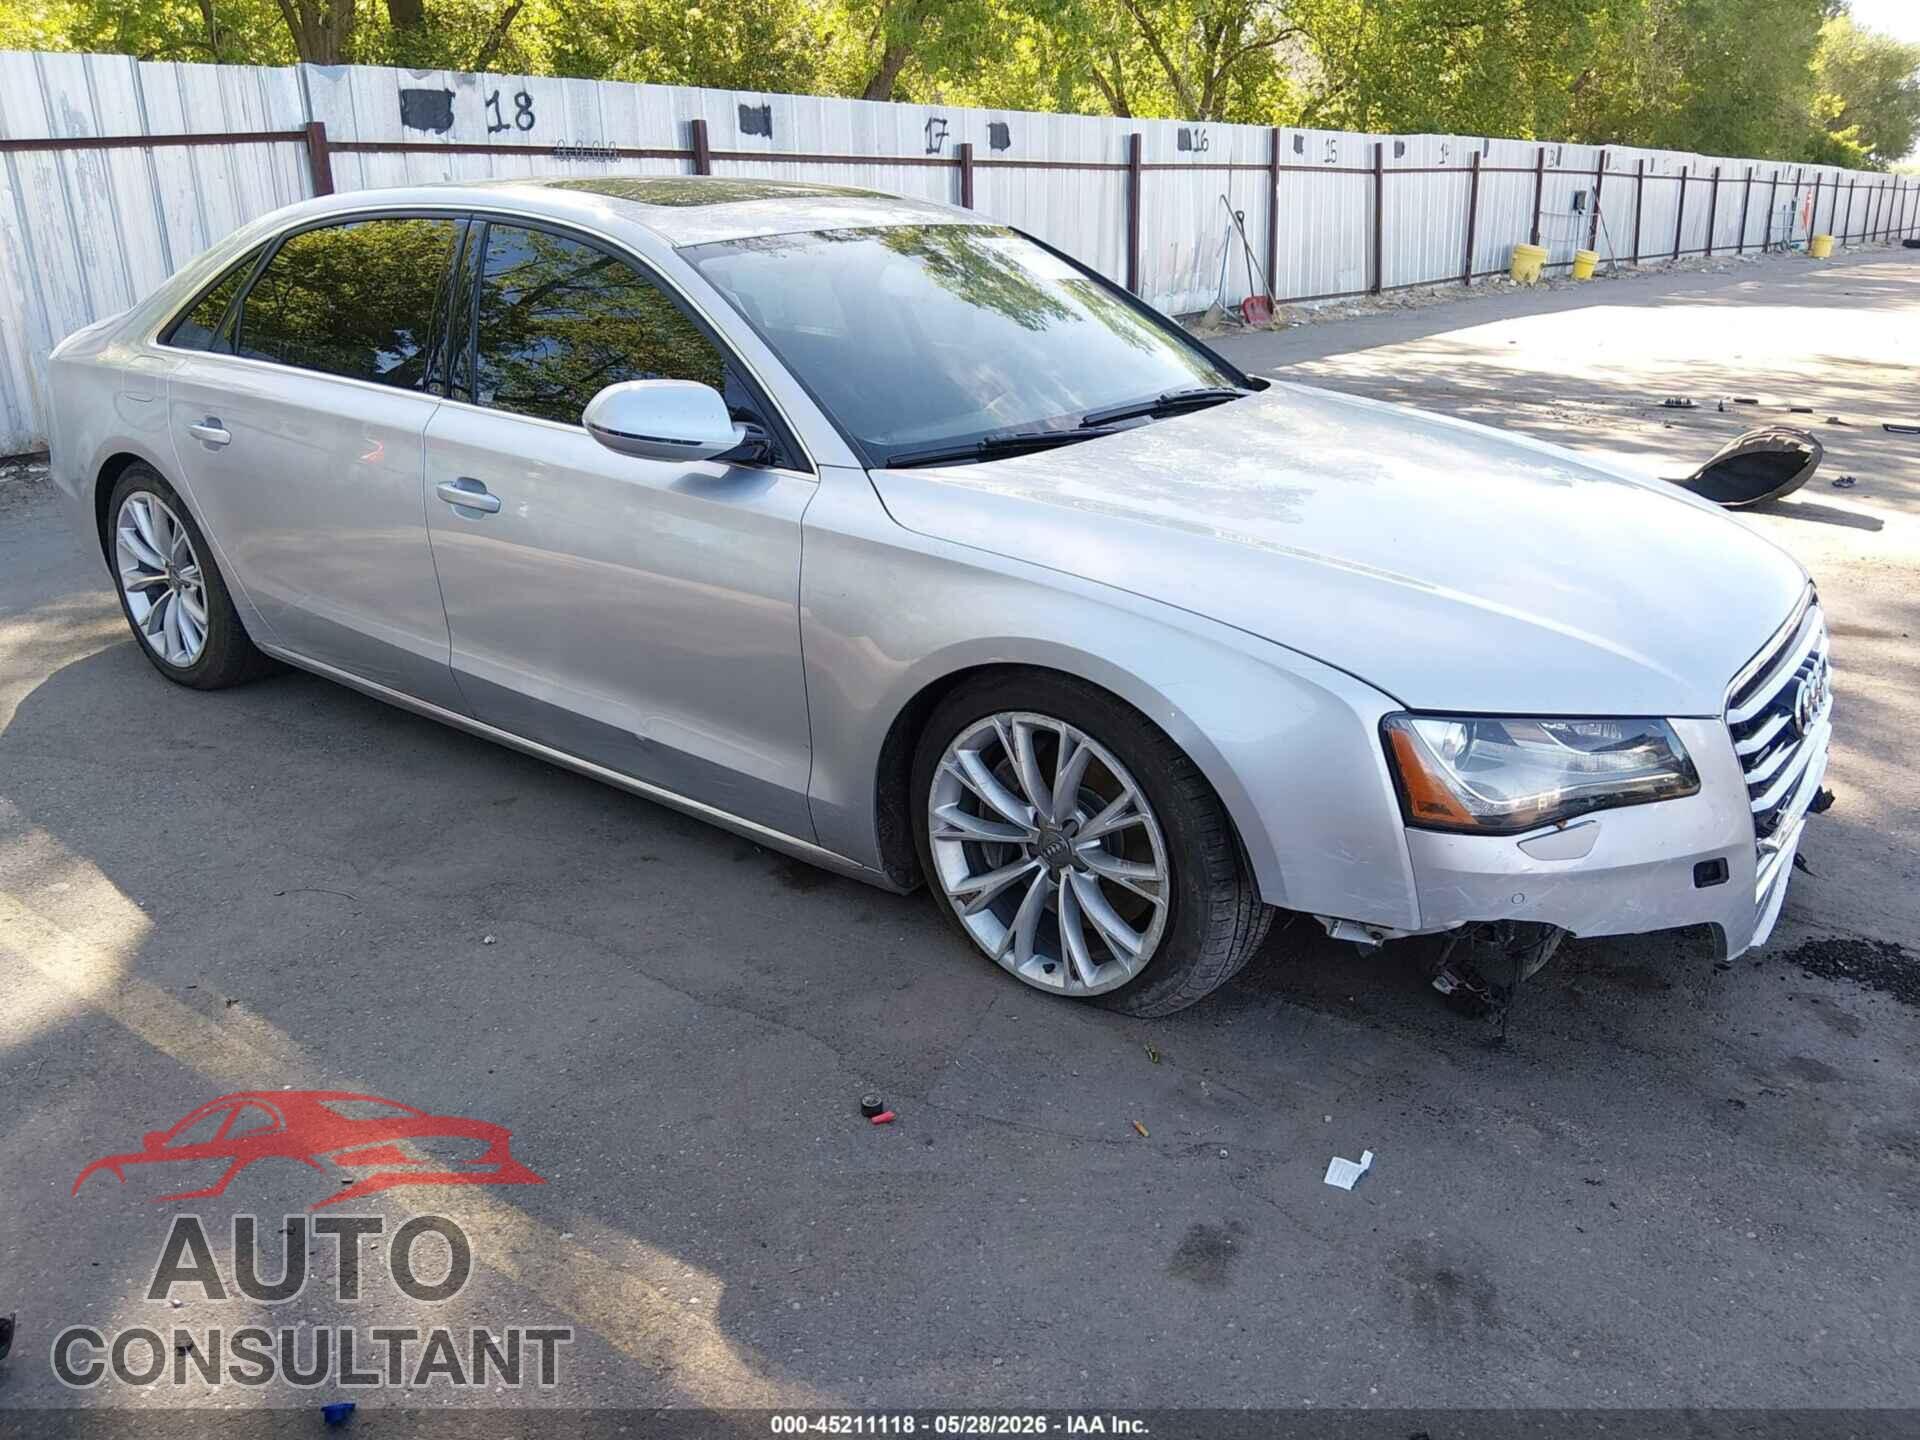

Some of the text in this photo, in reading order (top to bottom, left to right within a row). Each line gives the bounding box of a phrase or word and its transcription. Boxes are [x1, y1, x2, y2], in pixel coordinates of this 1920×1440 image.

[485, 89, 535, 133] 18
[924, 117, 949, 155] 17
[1193, 127, 1209, 152] 16
[1324, 138, 1338, 163] 15
